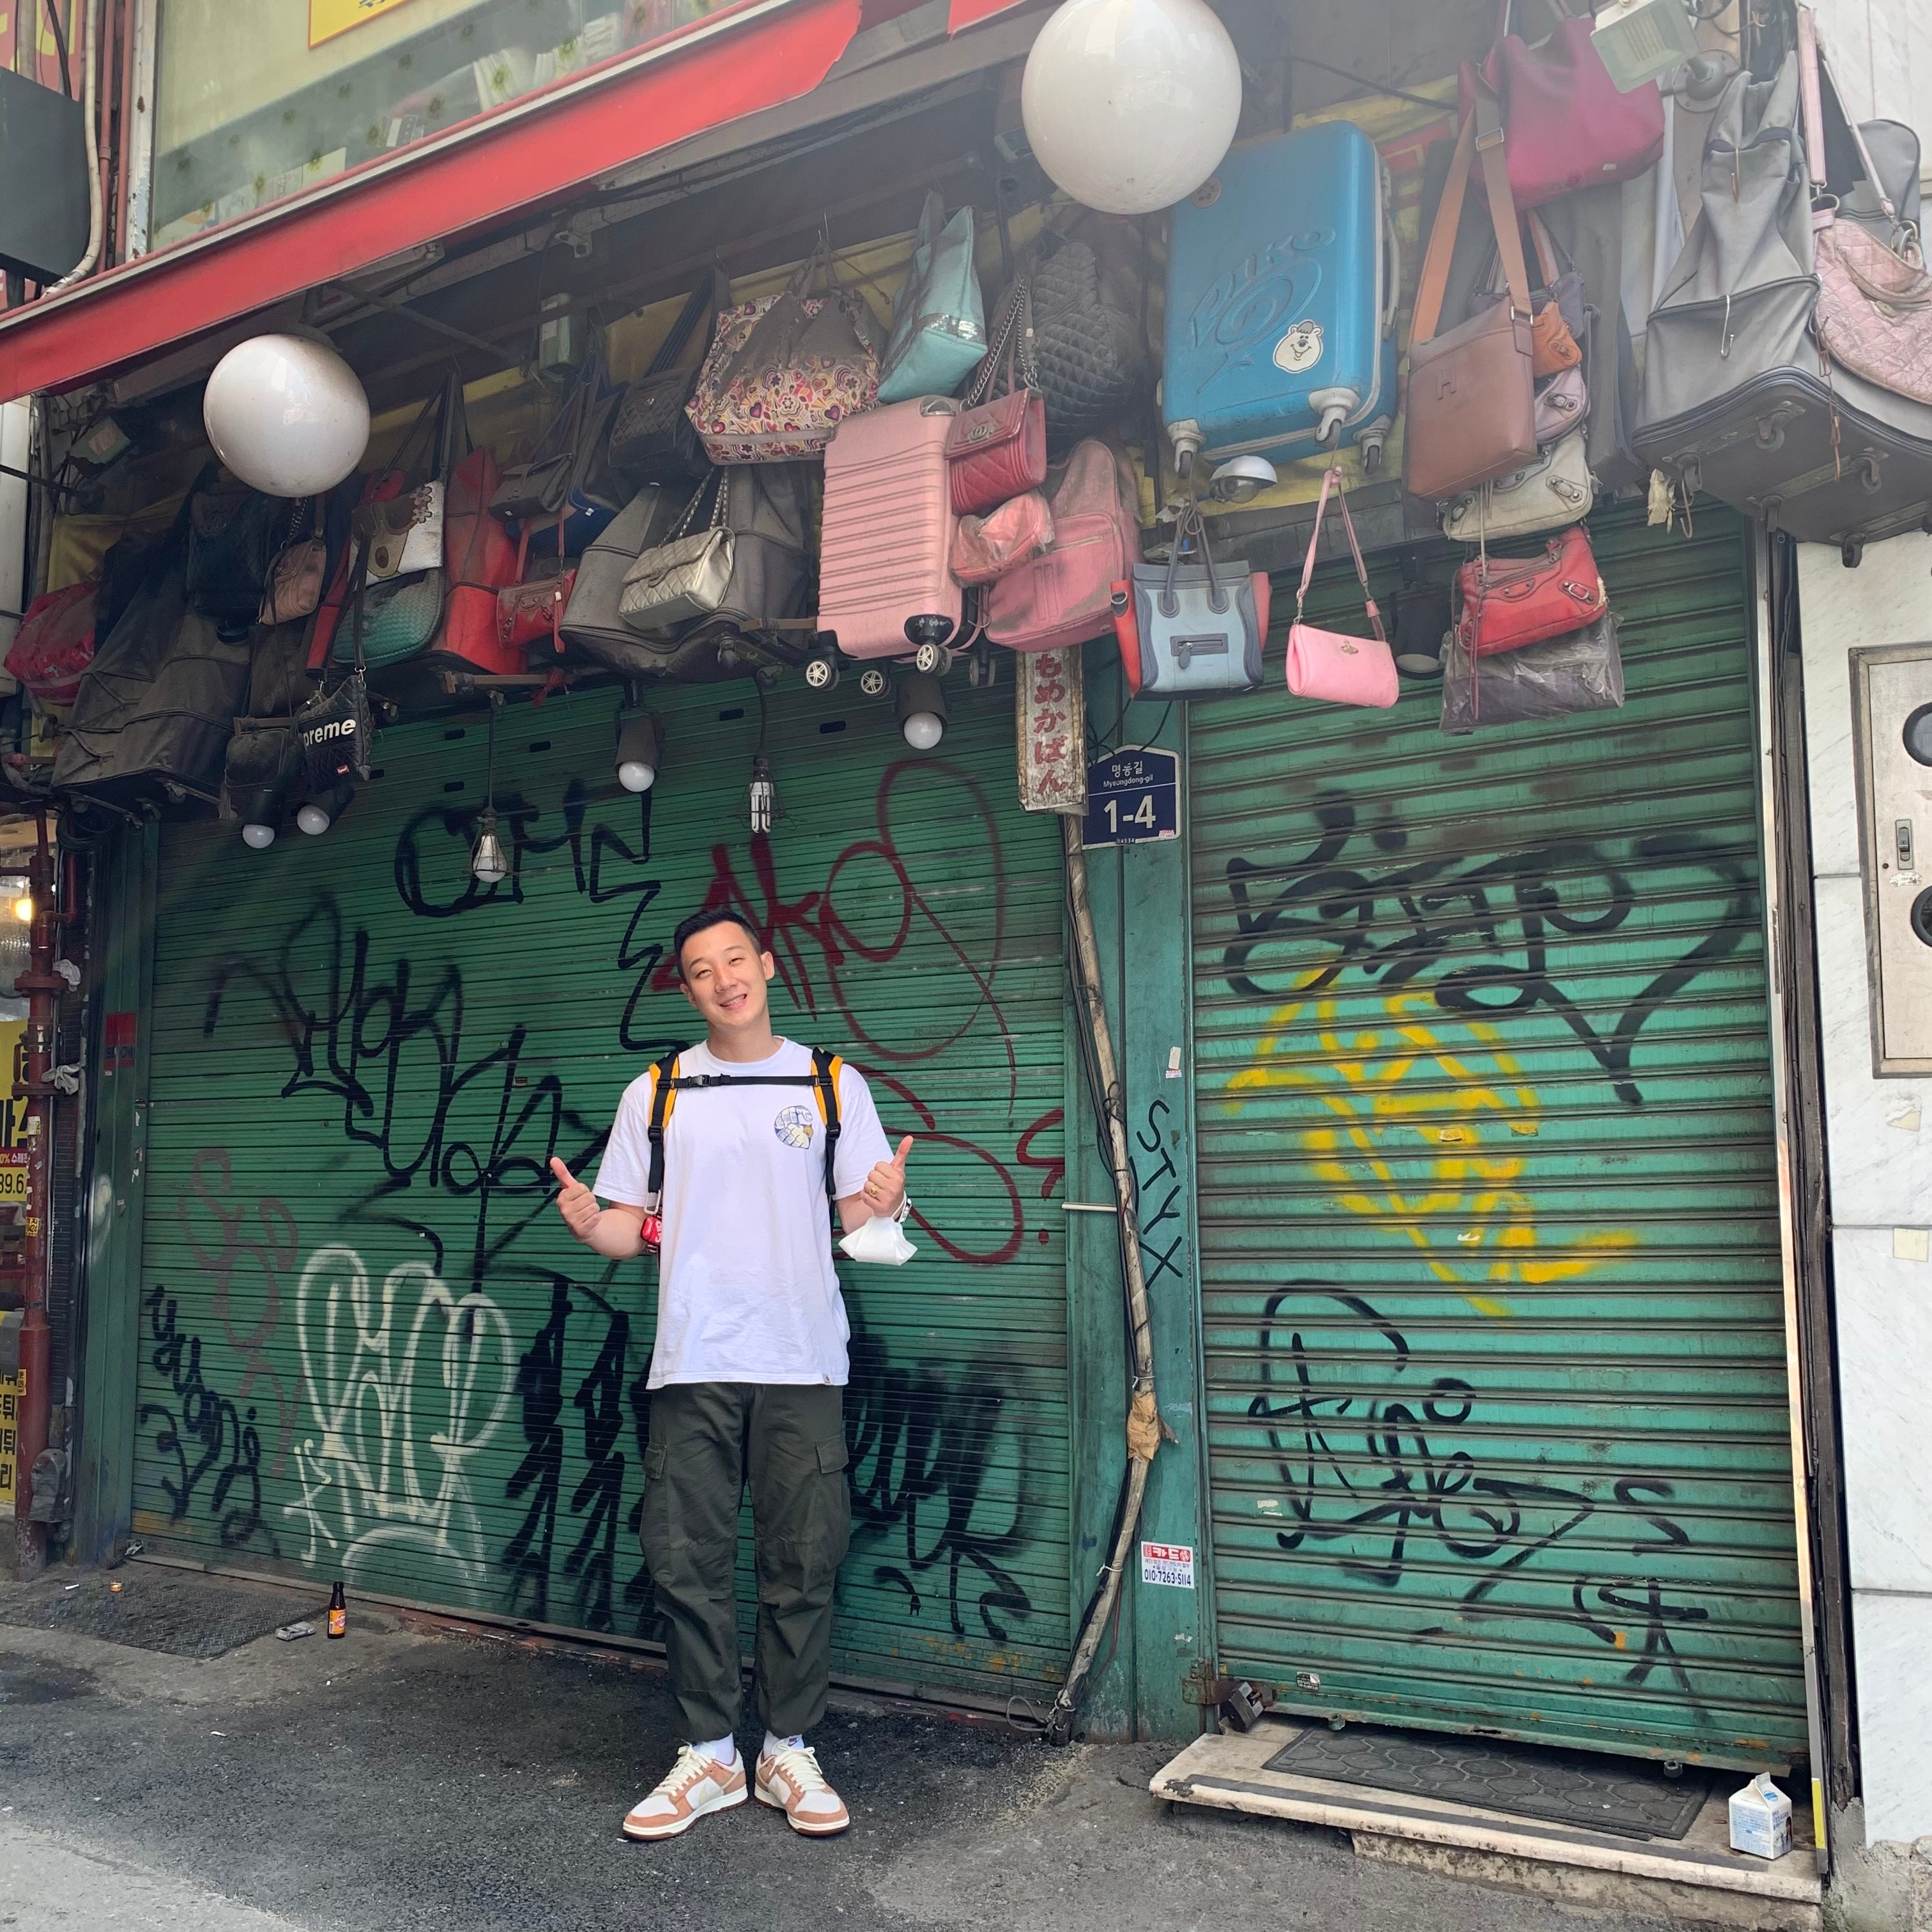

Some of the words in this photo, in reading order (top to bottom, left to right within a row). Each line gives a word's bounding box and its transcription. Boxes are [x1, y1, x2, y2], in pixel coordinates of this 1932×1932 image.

[1103, 774, 1154, 788] Myeongdong-gil
[1112, 760, 1144, 779] 명동길
[1103, 795, 1156, 834] 1-4
[1137, 1100, 1183, 1291] STYX
